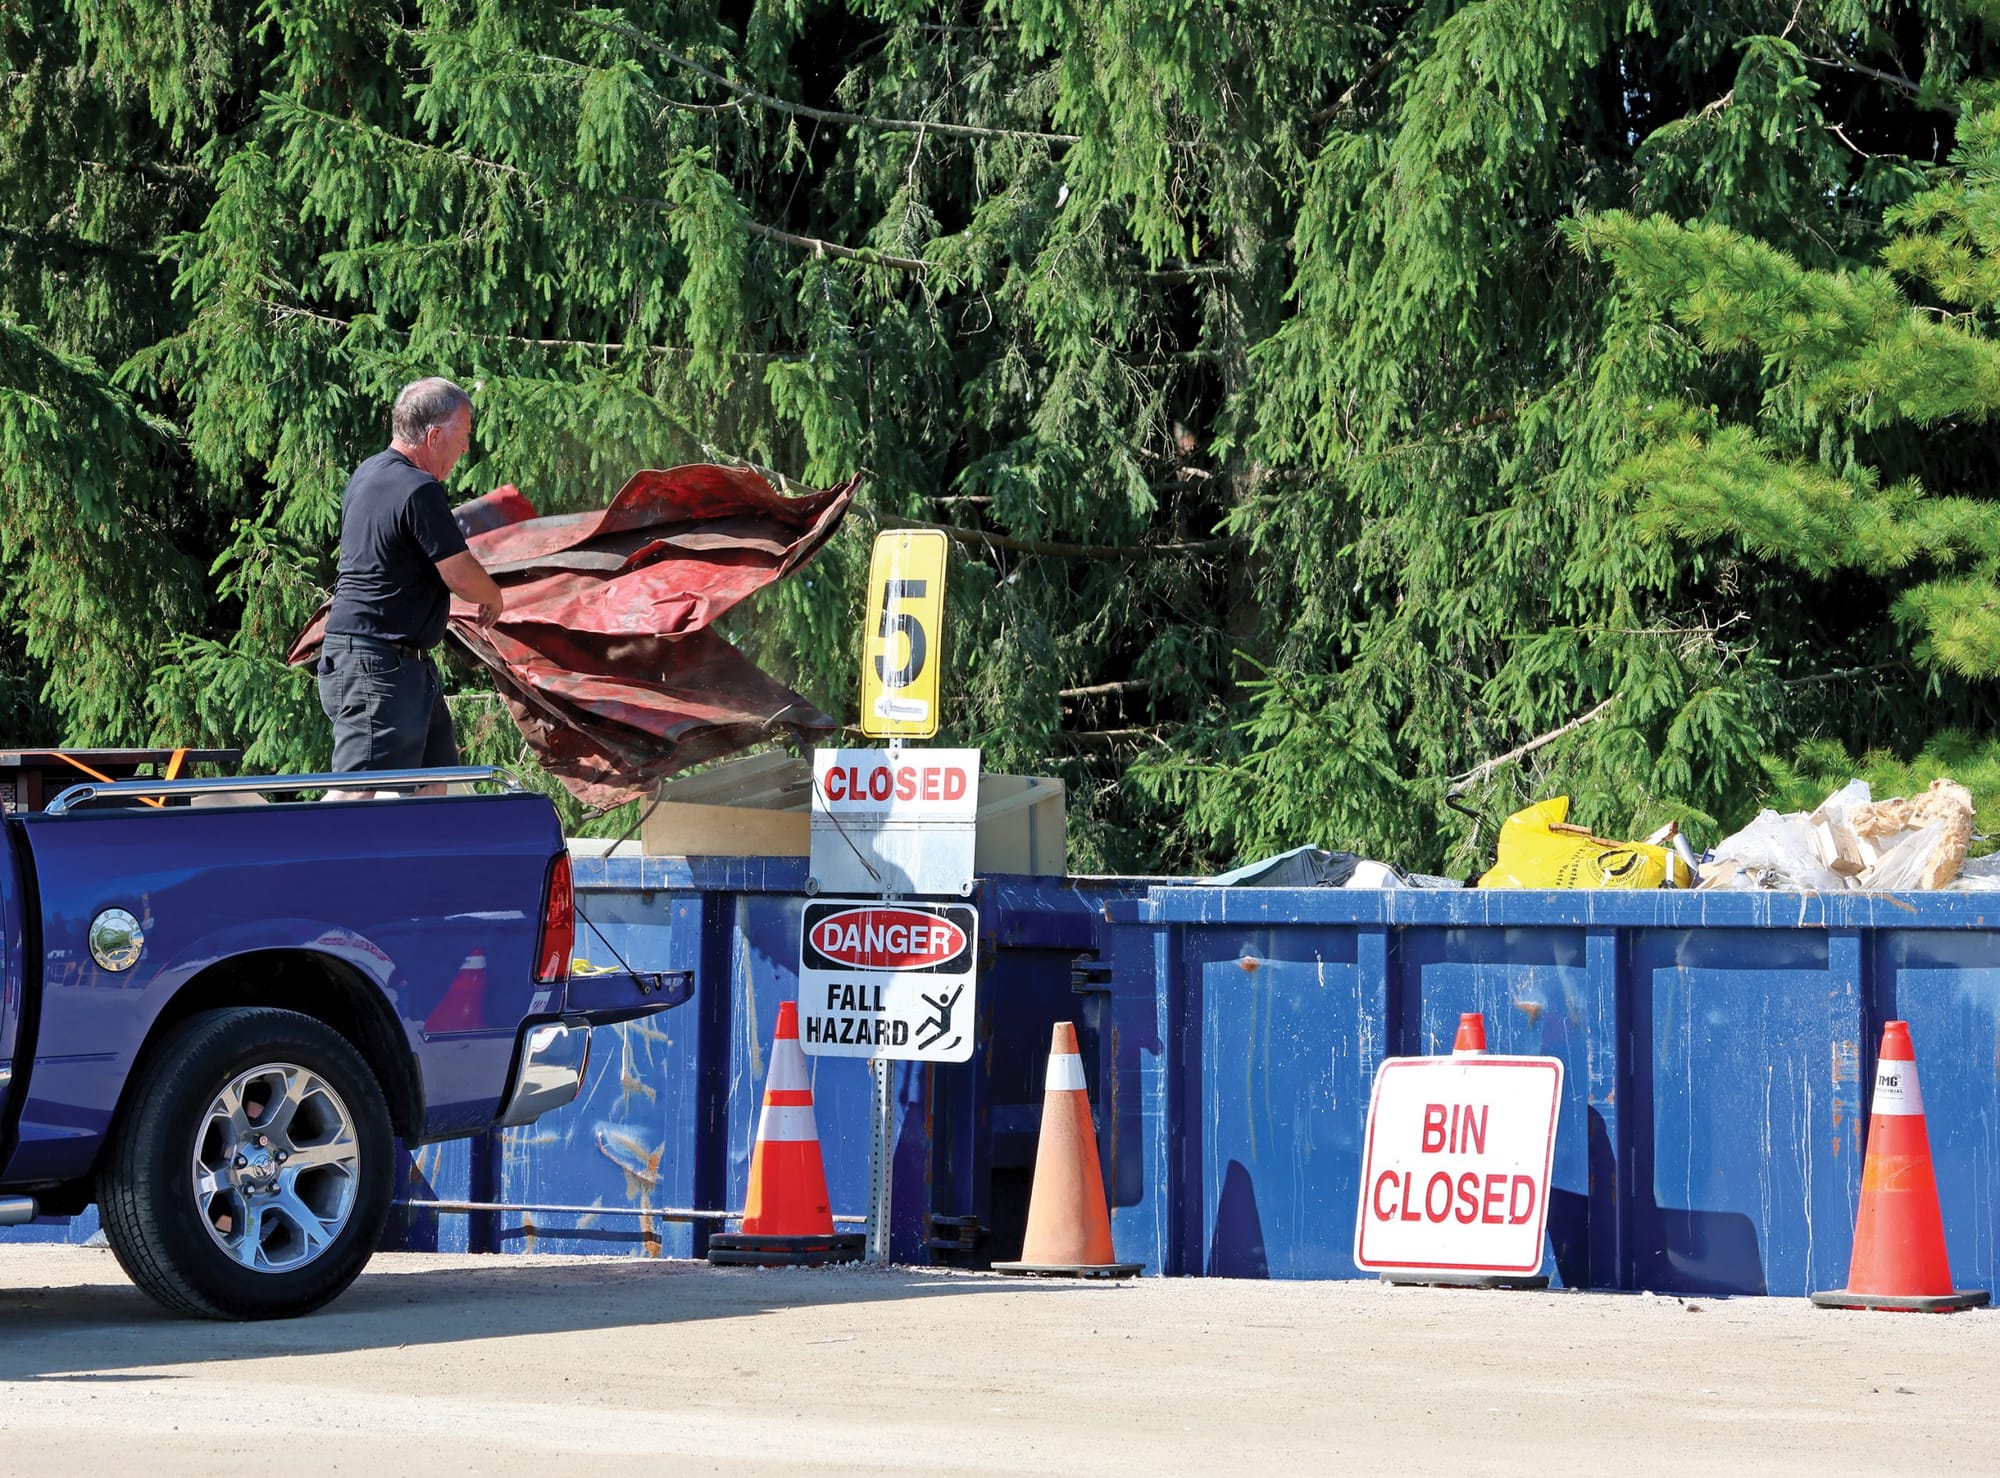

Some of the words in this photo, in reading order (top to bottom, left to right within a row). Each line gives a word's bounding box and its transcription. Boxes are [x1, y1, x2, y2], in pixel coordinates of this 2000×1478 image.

[875, 580, 927, 687] 5
[824, 766, 967, 801] CLOSED
[823, 923, 950, 955] DANGER
[827, 983, 886, 1012] FALL
[806, 1016, 909, 1046] HAZARD
[1879, 1075, 1898, 1087] TMG
[1421, 1103, 1489, 1155] BIN
[1373, 1170, 1536, 1225] CLOSED
